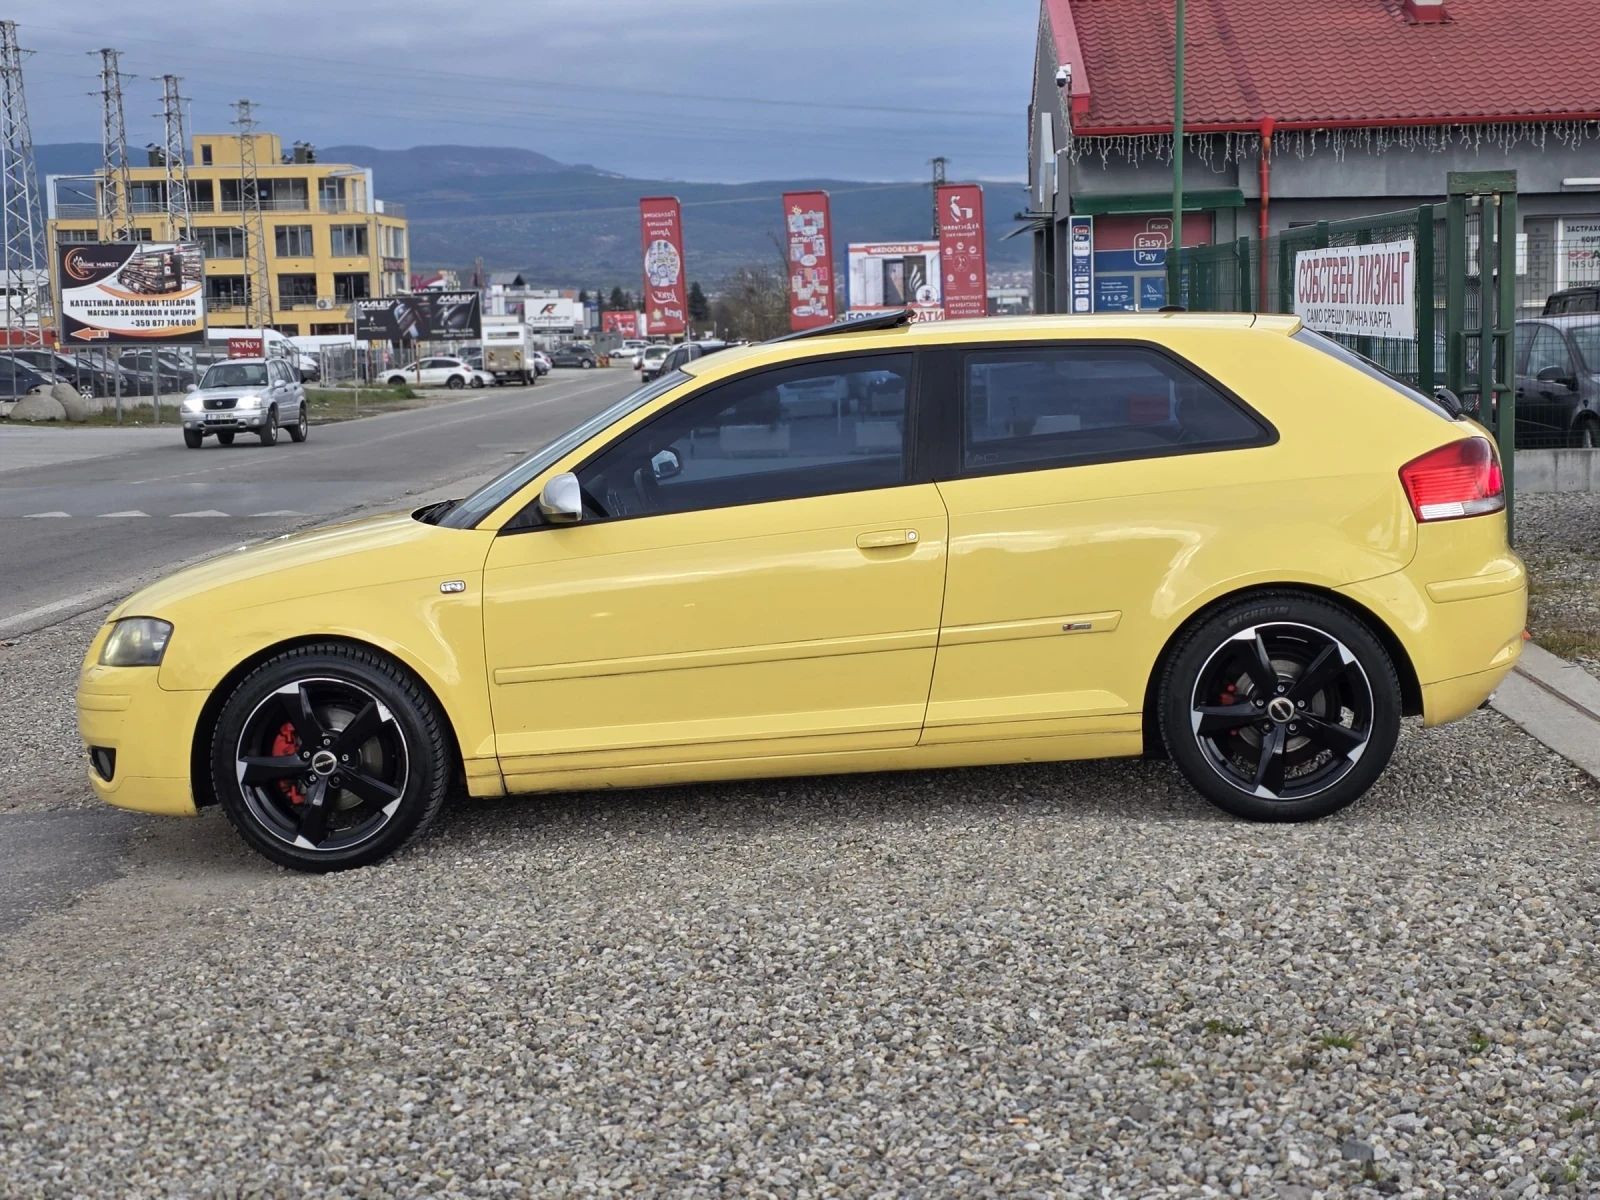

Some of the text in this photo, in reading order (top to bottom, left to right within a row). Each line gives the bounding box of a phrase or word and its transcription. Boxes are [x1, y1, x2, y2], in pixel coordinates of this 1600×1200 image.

[1138, 237, 1162, 248] Easy
[870, 245, 919, 253] MRDOORS.BG
[1138, 251, 1157, 262] Pay
[1299, 251, 1410, 306] СОБСТВЕН ЛИЗИНГ
[87, 309, 119, 317] МАГАЗИН
[130, 309, 162, 317] АЛКОХОЛ
[170, 309, 196, 317] ЦИГАРИ
[1306, 308, 1392, 329] САМО СРЕЩУ ЛИЧНА КАРТА
[1227, 606, 1289, 628] MICHELIN
